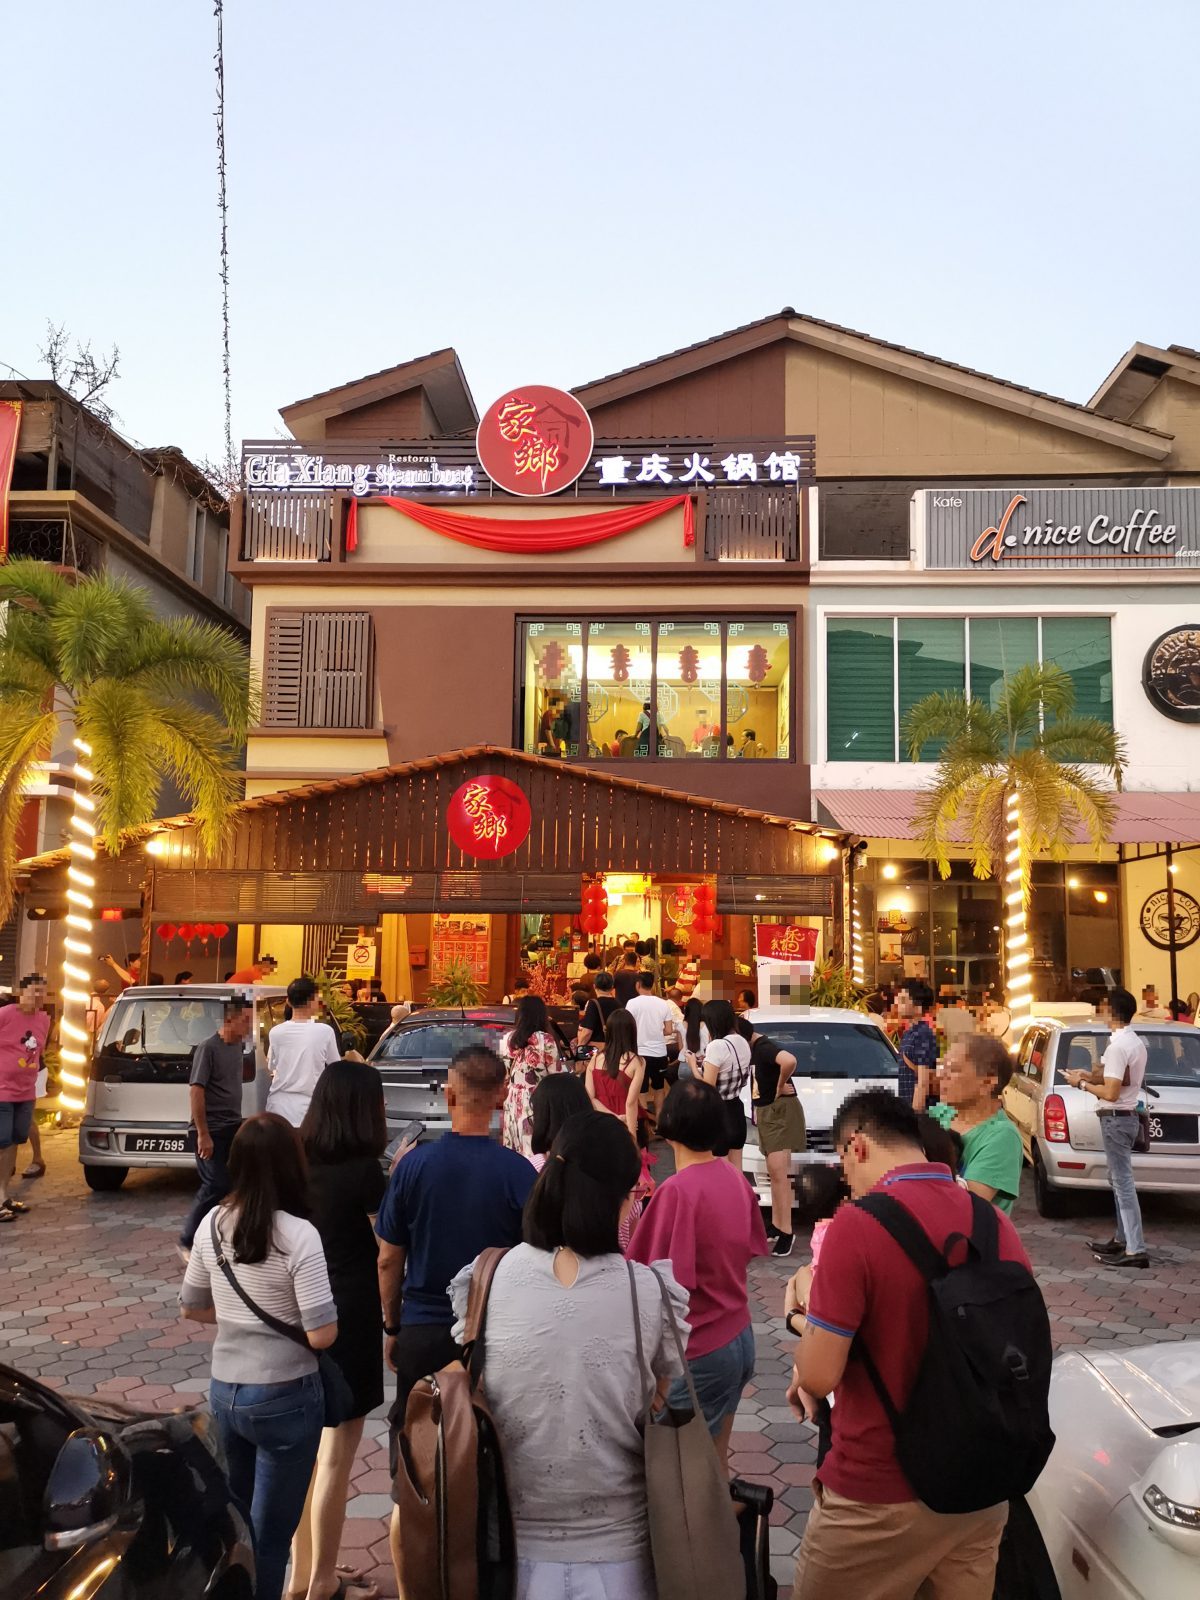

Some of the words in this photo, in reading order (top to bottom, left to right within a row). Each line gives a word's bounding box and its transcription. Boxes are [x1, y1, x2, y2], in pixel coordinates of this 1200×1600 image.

[388, 454, 437, 464] Restoran
[595, 451, 801, 485] 重庆火锅馆
[245, 454, 291, 485] Gia
[294, 454, 370, 496] Xiang
[375, 462, 474, 486] Steamboat
[933, 496, 963, 508] Kafe
[1022, 519, 1082, 546] nice
[1086, 508, 1177, 554] Coffee
[136, 1139, 157, 1151] PFF
[158, 1140, 185, 1151] 7595
